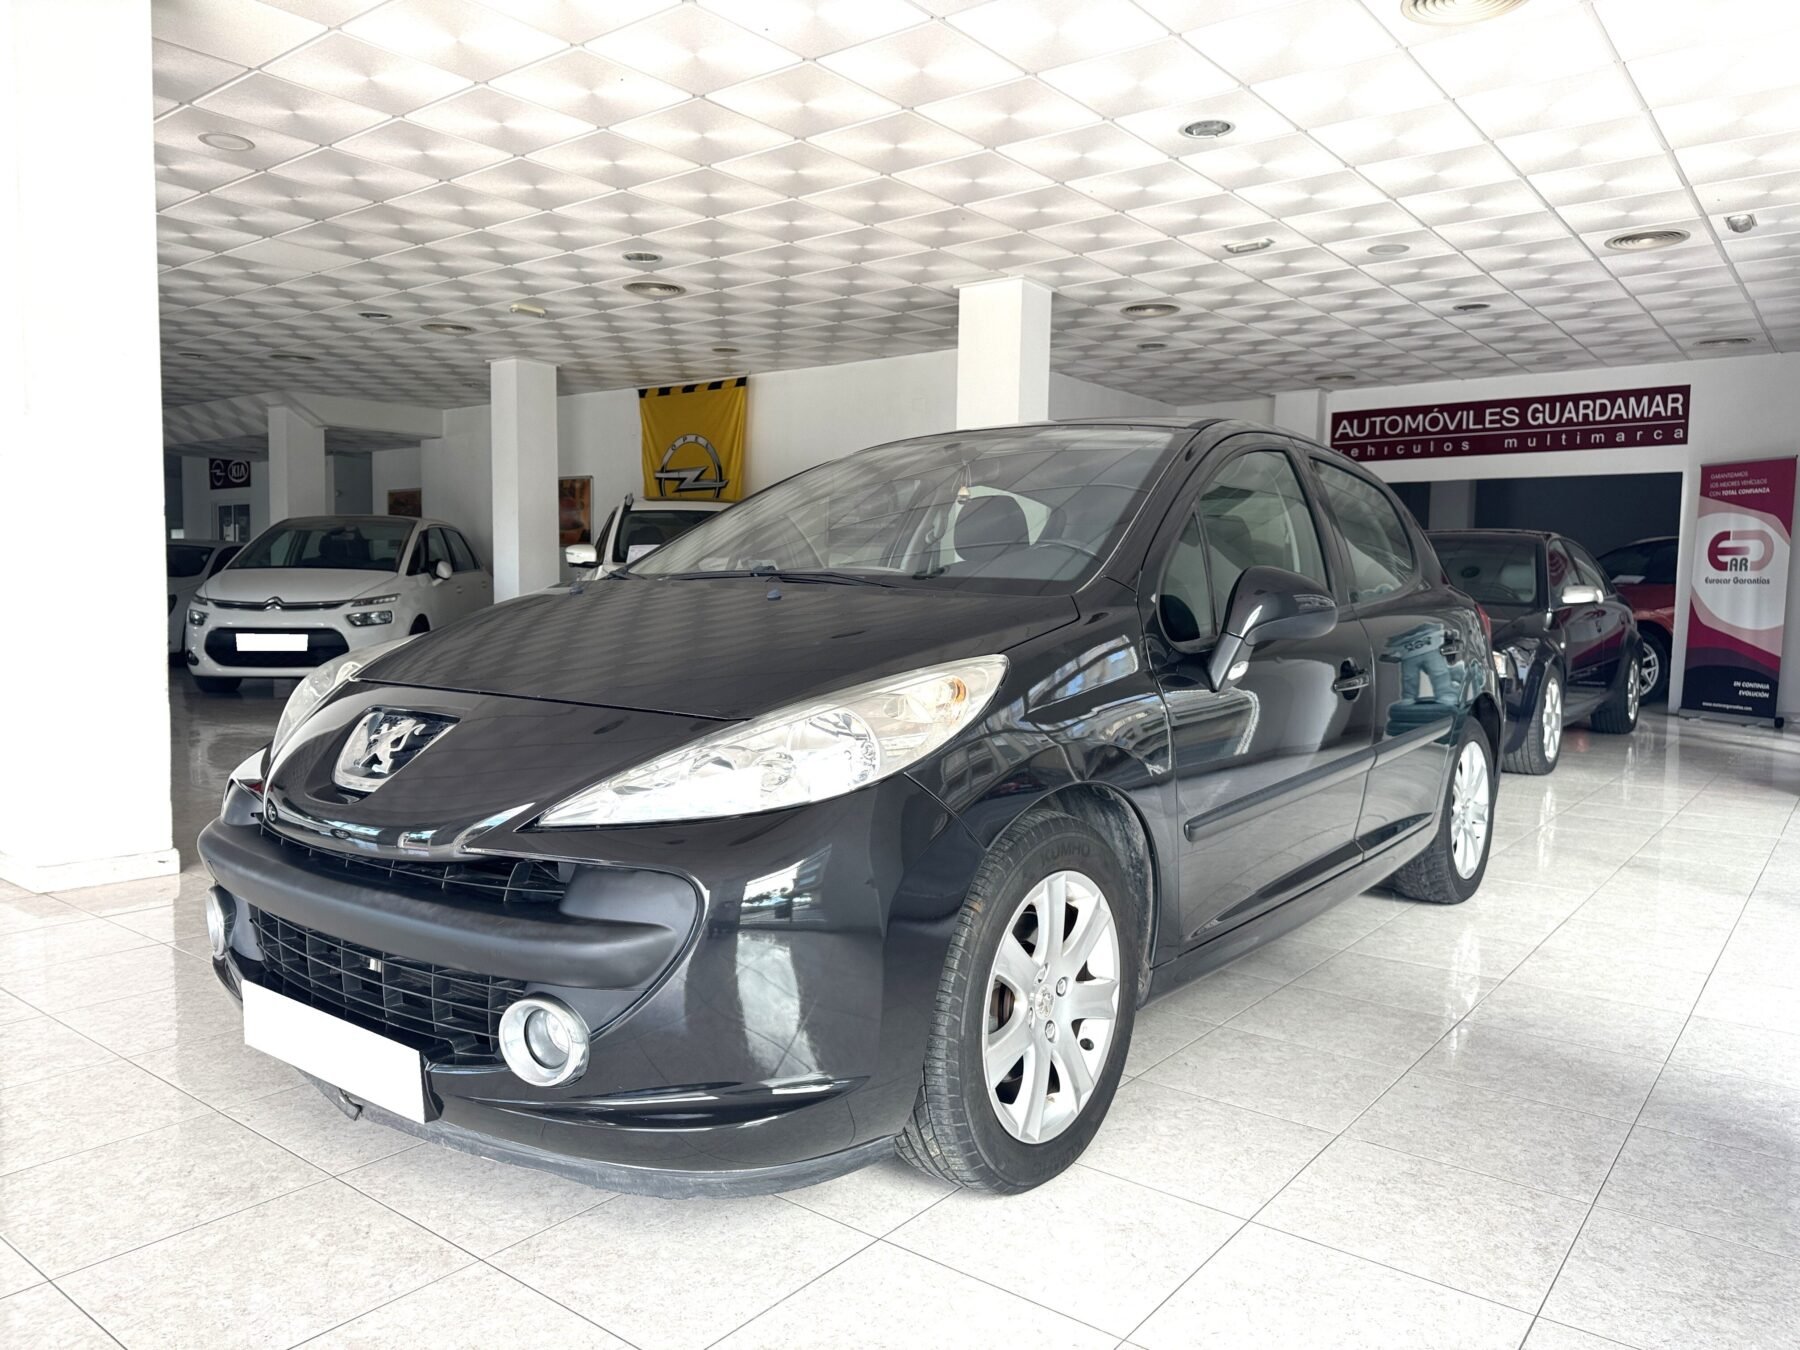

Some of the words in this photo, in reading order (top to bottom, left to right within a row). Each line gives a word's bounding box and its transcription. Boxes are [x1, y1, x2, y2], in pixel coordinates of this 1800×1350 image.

[1335, 407, 1520, 439] AUTOMÓVILES
[1527, 393, 1684, 426] GUARDAMAR
[1504, 427, 1684, 449] multimarca
[231, 464, 246, 477] KIA
[1738, 487, 1770, 496] CONFIANZA
